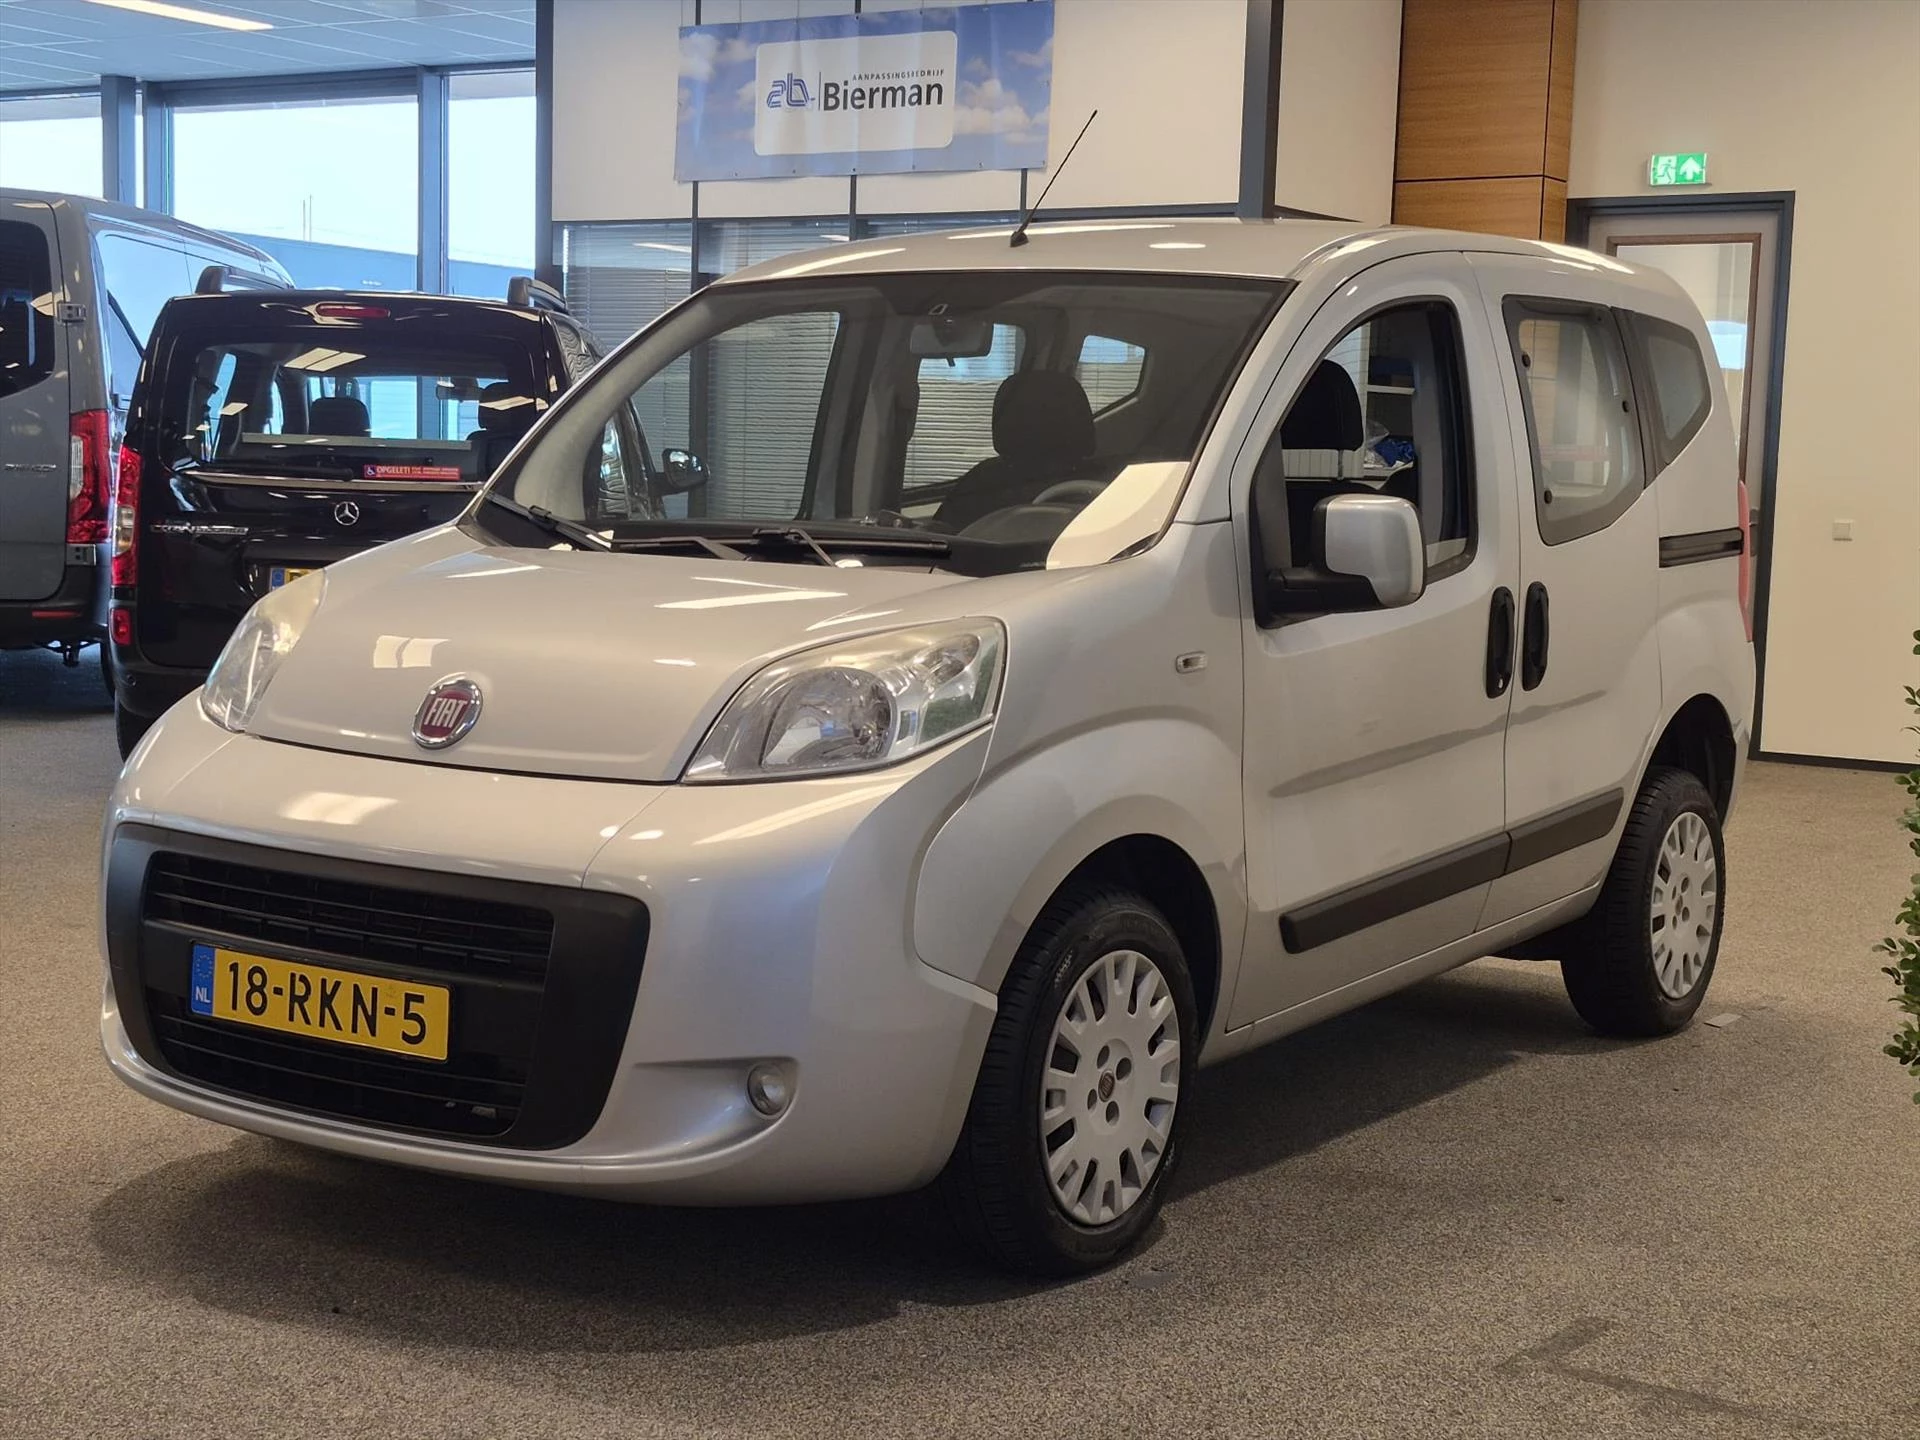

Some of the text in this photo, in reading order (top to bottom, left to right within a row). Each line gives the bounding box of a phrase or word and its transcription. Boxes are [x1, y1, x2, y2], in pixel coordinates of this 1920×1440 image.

[852, 68, 945, 81] AANPASSINGSBEDRIJF
[823, 80, 943, 111] Bierman
[423, 697, 469, 729] FIAT
[195, 985, 211, 1004] NL
[228, 961, 427, 1046] 18-RKN-5
